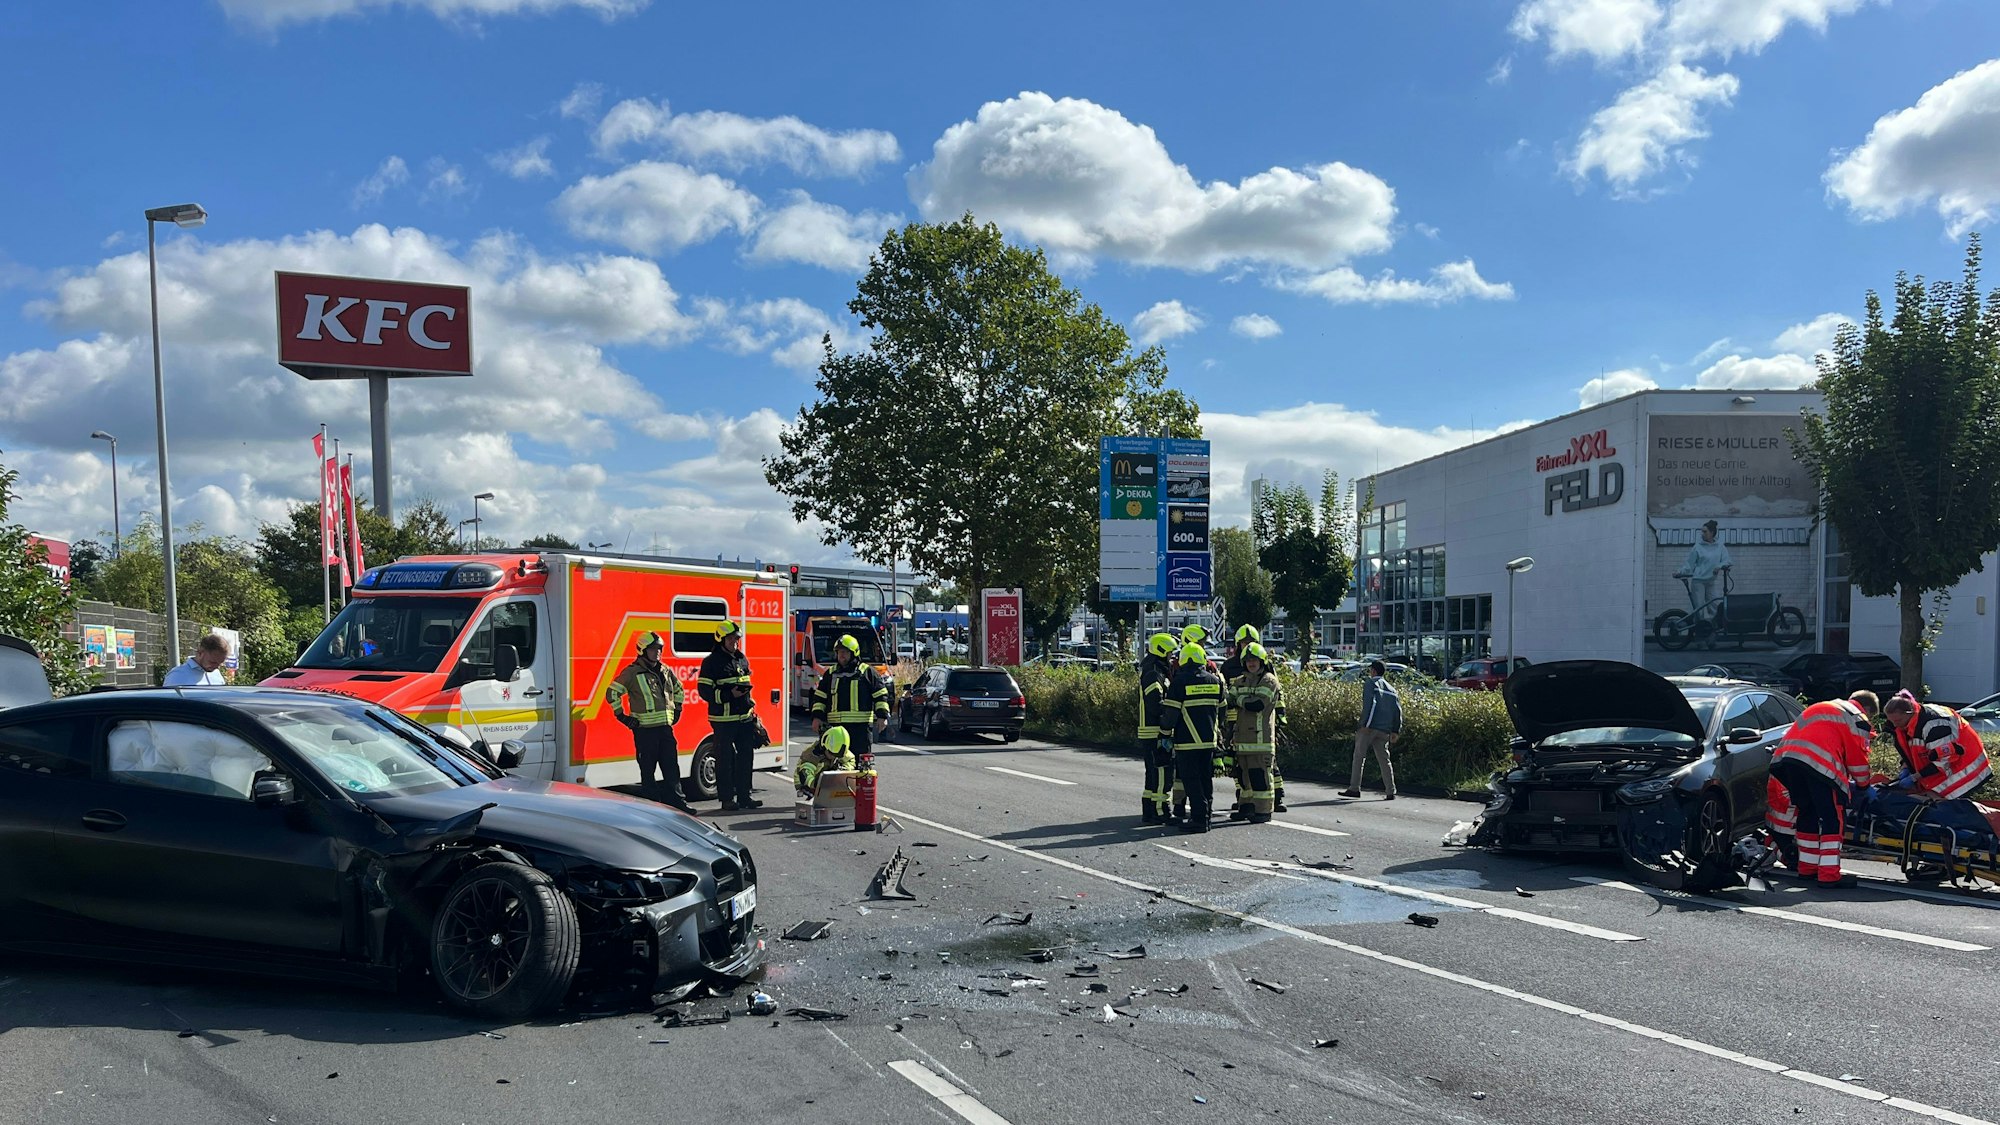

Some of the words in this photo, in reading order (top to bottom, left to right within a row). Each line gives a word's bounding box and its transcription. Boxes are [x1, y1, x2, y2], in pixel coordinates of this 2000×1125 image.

[296, 293, 456, 350] KFC
[1570, 429, 1616, 464] XXL
[1658, 437, 1703, 449] RIESE
[1706, 438, 1715, 448] &
[1717, 437, 1779, 449] MÜLLER
[1657, 458, 1678, 470] Das
[1681, 460, 1711, 470] neue
[1657, 475, 1671, 486] So
[1674, 475, 1715, 486] flexibel
[1719, 475, 1739, 486] wie
[1742, 475, 1756, 486] Ihr
[1126, 489, 1152, 498] DEKRA
[1544, 462, 1624, 516] FELD
[1173, 532, 1195, 543] 600
[379, 570, 448, 584] RETTUNGSDIENST
[1112, 585, 1145, 594] Wegweiser
[760, 600, 779, 616] 112
[991, 609, 1018, 617] FELD
[483, 724, 529, 733] RHEIN-SIEG-KREIS
